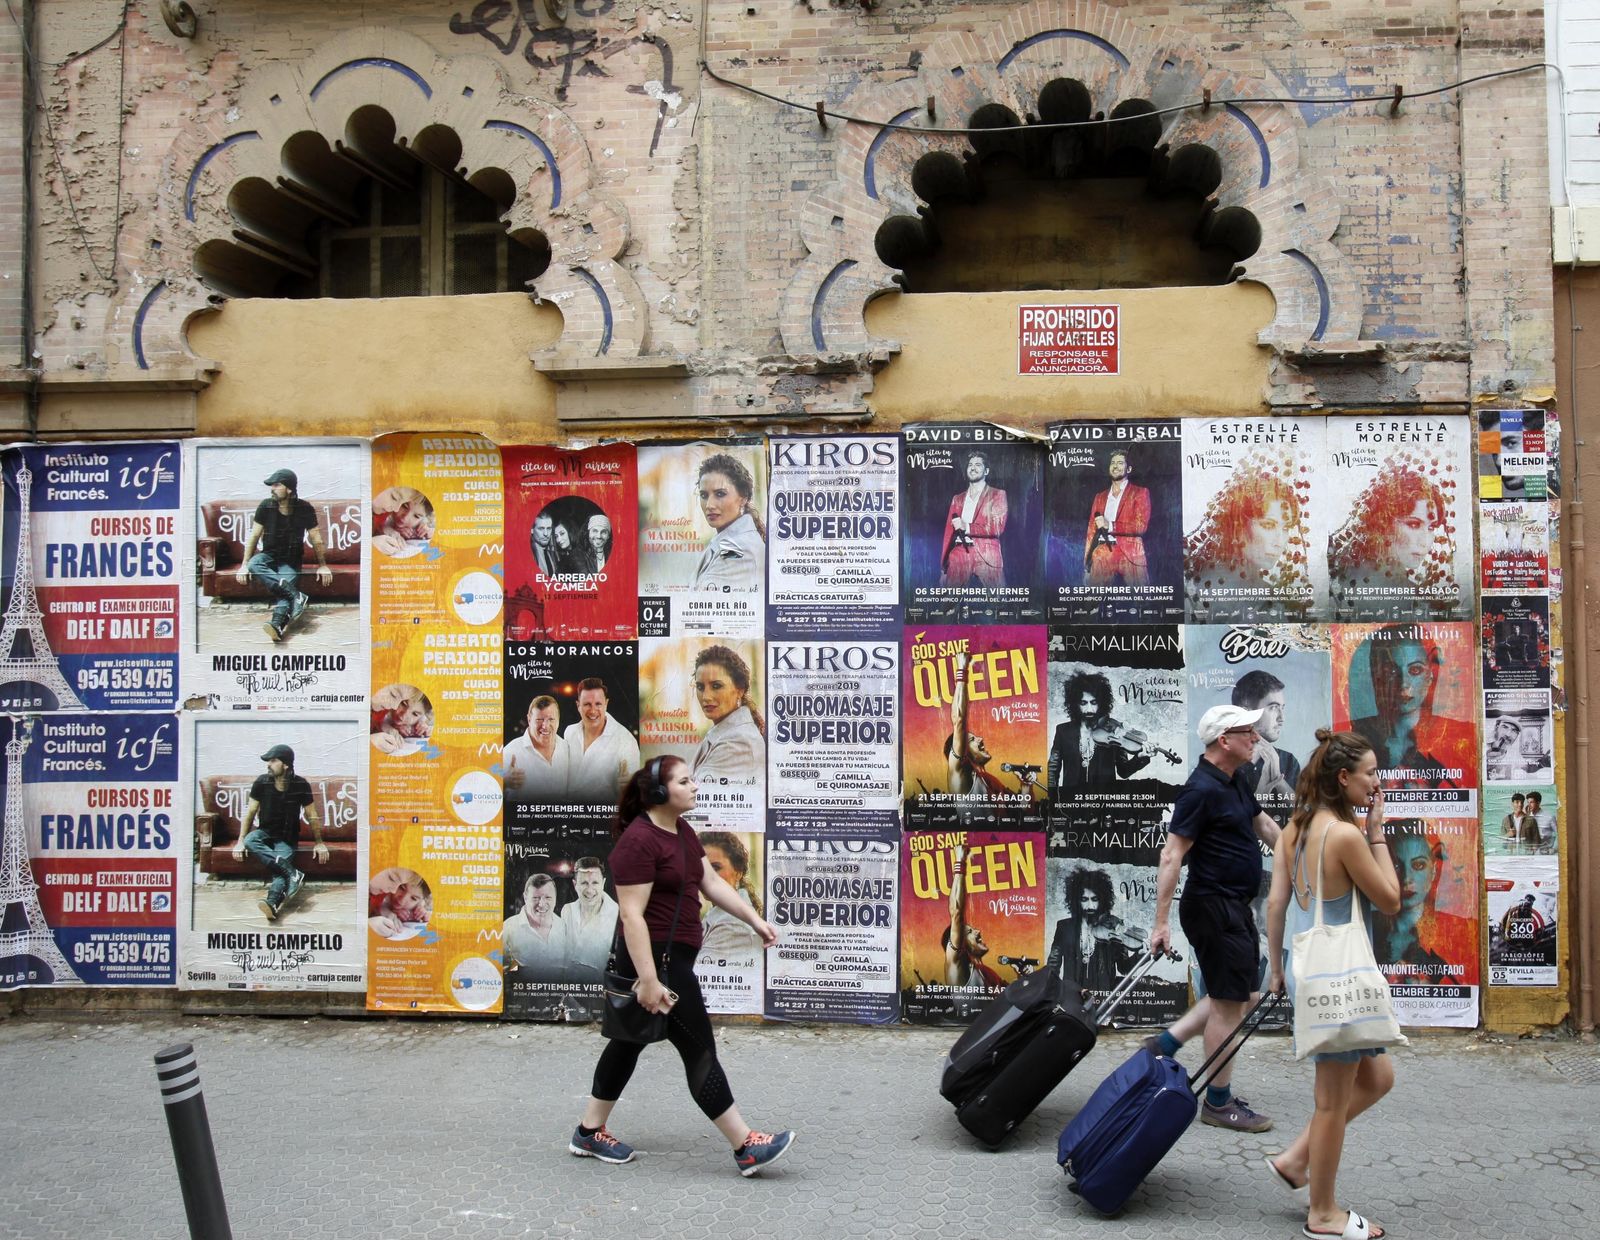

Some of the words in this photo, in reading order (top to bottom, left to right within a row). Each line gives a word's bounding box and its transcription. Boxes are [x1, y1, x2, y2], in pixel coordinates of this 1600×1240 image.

[1024, 309, 1114, 329] PROHIBIDO
[1024, 332, 1054, 346] FIJAR
[1057, 331, 1114, 346] CARTELES
[1030, 350, 1108, 358] RESPONSABLE
[1050, 428, 1103, 441] DAVID
[1116, 426, 1181, 440] BISBAL
[1210, 424, 1300, 433] ESTRELLA
[1356, 422, 1447, 432] ESTRELLA
[906, 430, 961, 441] DAVID
[1213, 434, 1298, 444] MORENTE
[1360, 433, 1444, 442] MORENTE
[45, 454, 108, 467] Instituto
[774, 442, 895, 468] KIROS
[520, 462, 542, 472] cita
[544, 462, 556, 472] en
[560, 456, 620, 478] Mairena
[1504, 458, 1544, 466] MELENDI
[47, 470, 109, 483] Cultural
[120, 452, 172, 500] icf
[838, 478, 860, 486] 2019
[48, 488, 109, 500] Francés.
[774, 492, 894, 515] QUIROMASAJE
[91, 517, 151, 536] CURSOS
[156, 517, 174, 535] DE
[778, 516, 892, 539] SUPERIOR
[648, 531, 700, 540] MARISOL
[643, 542, 705, 552] BIZCOCHO
[46, 537, 173, 578] FRANCÉS
[782, 566, 820, 575] OBSEQUIO
[836, 568, 872, 576] CAMILLA
[536, 573, 548, 582] EL
[550, 573, 608, 582] ARREBATO
[544, 582, 552, 592] Y
[554, 582, 598, 592] CAMELA
[1073, 586, 1130, 594] SEPTIEMBRE
[1199, 588, 1208, 596] 14
[1212, 588, 1270, 596] SEPTIEMBRE
[1273, 586, 1314, 596] SÁBADO
[776, 592, 819, 600] PRÁCTICAS
[50, 602, 84, 613] CENTRO
[86, 602, 97, 612] DE
[102, 601, 136, 612] EXAMEN
[138, 600, 172, 612] OFICIAL
[689, 602, 714, 610] CORIA
[716, 602, 731, 610] DEL
[734, 602, 748, 610] RÍO
[643, 608, 664, 621] 04
[67, 619, 106, 640] DELF
[110, 619, 150, 639] DALF
[1398, 625, 1461, 640] villalón
[424, 634, 501, 648] ABIERTO
[508, 647, 536, 656] LOS
[545, 646, 634, 656] MORANCOS
[912, 643, 936, 660] GOD
[938, 639, 970, 658] SAVE
[212, 655, 268, 671] MIGUEL
[272, 655, 346, 671] CAMPELLO
[424, 652, 501, 665] PERIODO
[772, 646, 894, 672] KIROS
[424, 667, 502, 676] MATRICULACIÓN
[510, 664, 553, 680] Mairena
[912, 648, 1039, 708] QUEEN
[77, 669, 109, 689] 954
[111, 669, 143, 689] 539
[145, 669, 173, 689] 475
[464, 680, 498, 688] CURSO
[1146, 677, 1164, 686] cita
[1168, 678, 1180, 688] en
[311, 695, 338, 704] cartuja
[442, 690, 501, 700] 2019-2020
[1118, 682, 1183, 705] Mairena
[774, 696, 893, 720] QUIROMASAJE
[44, 724, 106, 737] Instituto
[776, 721, 891, 744] SUPERIOR
[44, 740, 106, 754] Cultural
[43, 758, 106, 771] Francés.
[88, 789, 149, 808] CURSOS
[154, 789, 172, 807] DE
[930, 794, 988, 802] SEPTIEMBRE
[991, 792, 1032, 802] SÁBADO
[1432, 792, 1458, 800] 21:00
[1418, 804, 1432, 812] BOX
[1435, 804, 1470, 812] CARTUJA
[41, 809, 171, 850] FRANCÉS
[1401, 819, 1464, 836] villalón
[910, 840, 1037, 900] QUEEN
[773, 878, 892, 902] QUIROMASAJE
[775, 902, 890, 927] SUPERIOR
[1510, 922, 1534, 934] 360
[208, 933, 262, 950] MIGUEL
[266, 933, 342, 950] CAMPELLO
[188, 971, 216, 981] Sevilla
[1330, 976, 1358, 988] GREAT
[1307, 988, 1384, 1008] CORNISH
[1318, 1012, 1344, 1020] FOOD
[1348, 1006, 1378, 1016] STORE
